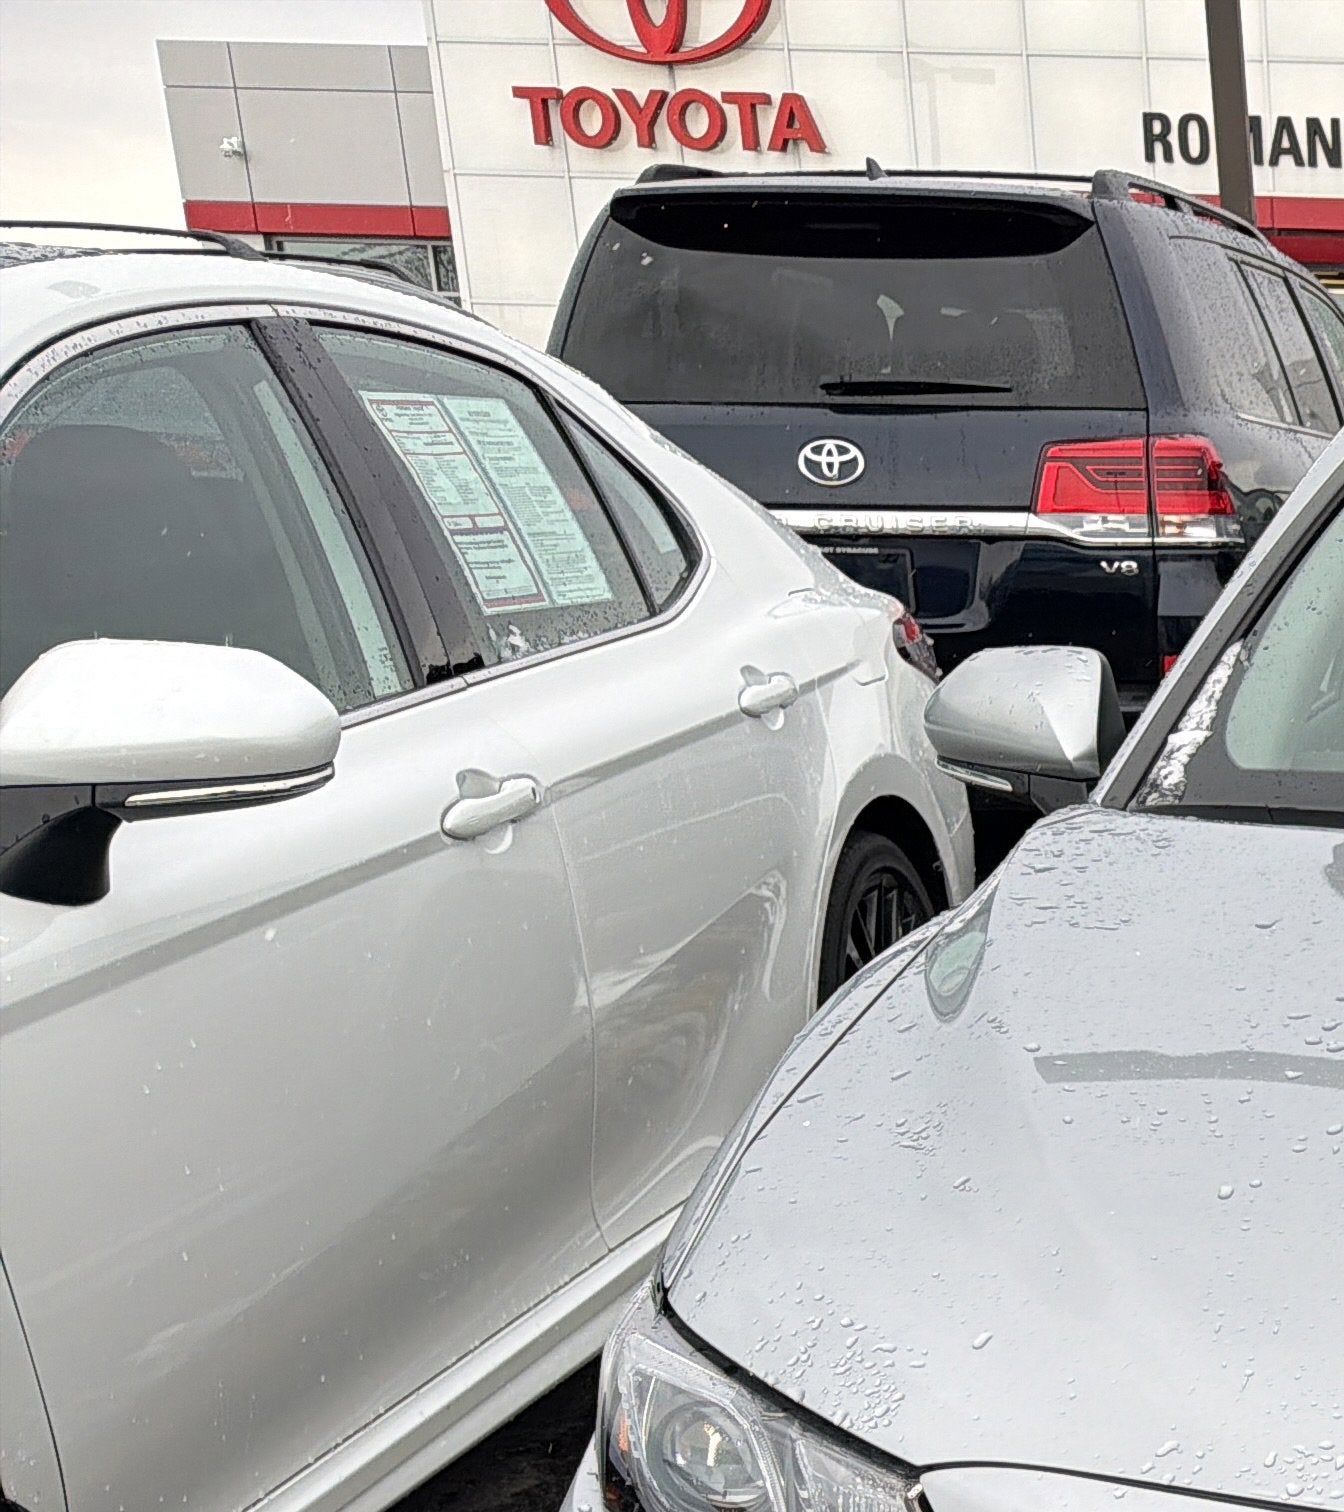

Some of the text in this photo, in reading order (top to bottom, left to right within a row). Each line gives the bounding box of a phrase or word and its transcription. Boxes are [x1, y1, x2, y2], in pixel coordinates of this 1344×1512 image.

[511, 85, 829, 153] TOYOTA
[814, 513, 975, 534] CRUISER
[1099, 559, 1140, 577] V8
